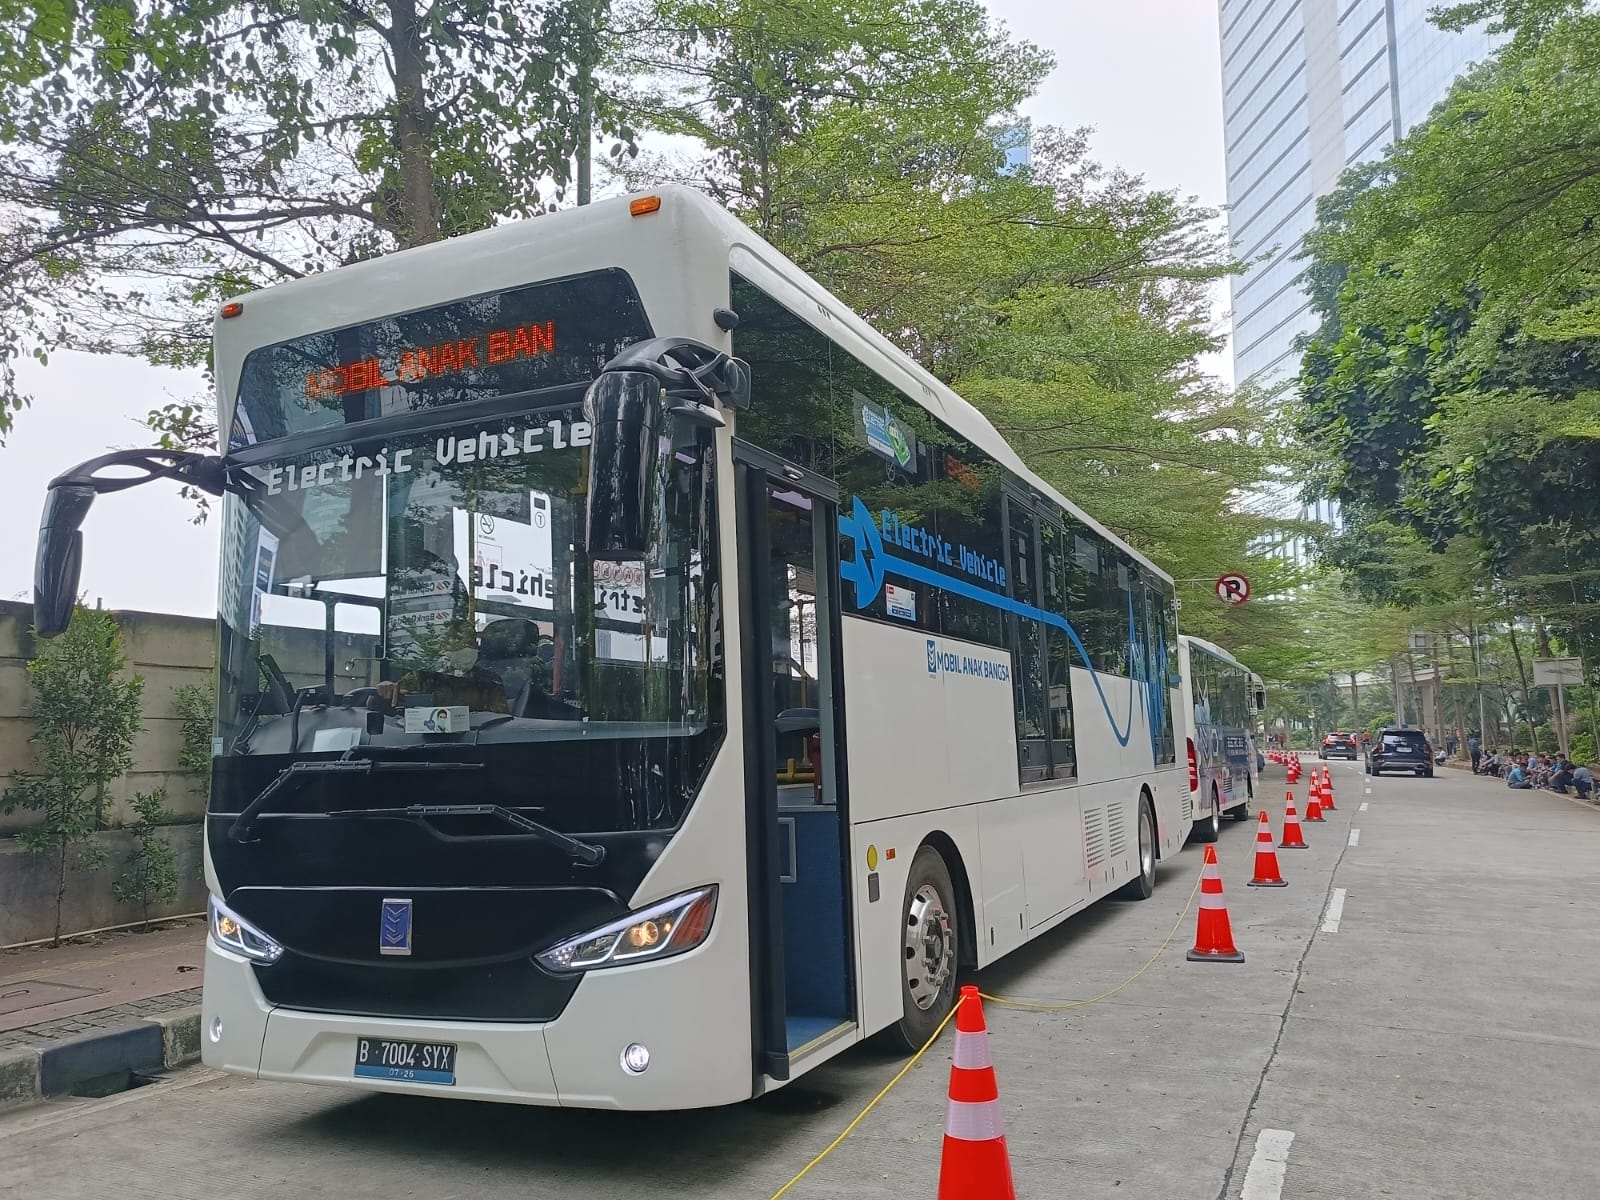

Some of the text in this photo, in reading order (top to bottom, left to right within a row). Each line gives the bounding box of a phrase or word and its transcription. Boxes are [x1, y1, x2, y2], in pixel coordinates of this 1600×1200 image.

[306, 321, 554, 400] MOBIL ANAK BAN
[267, 420, 591, 496] Electric Vehicle
[881, 507, 1006, 587] Electric Vehicle
[937, 651, 1009, 681] MOBIL ANAK BANGSA
[360, 1040, 369, 1062] B
[381, 1042, 416, 1066] 7004
